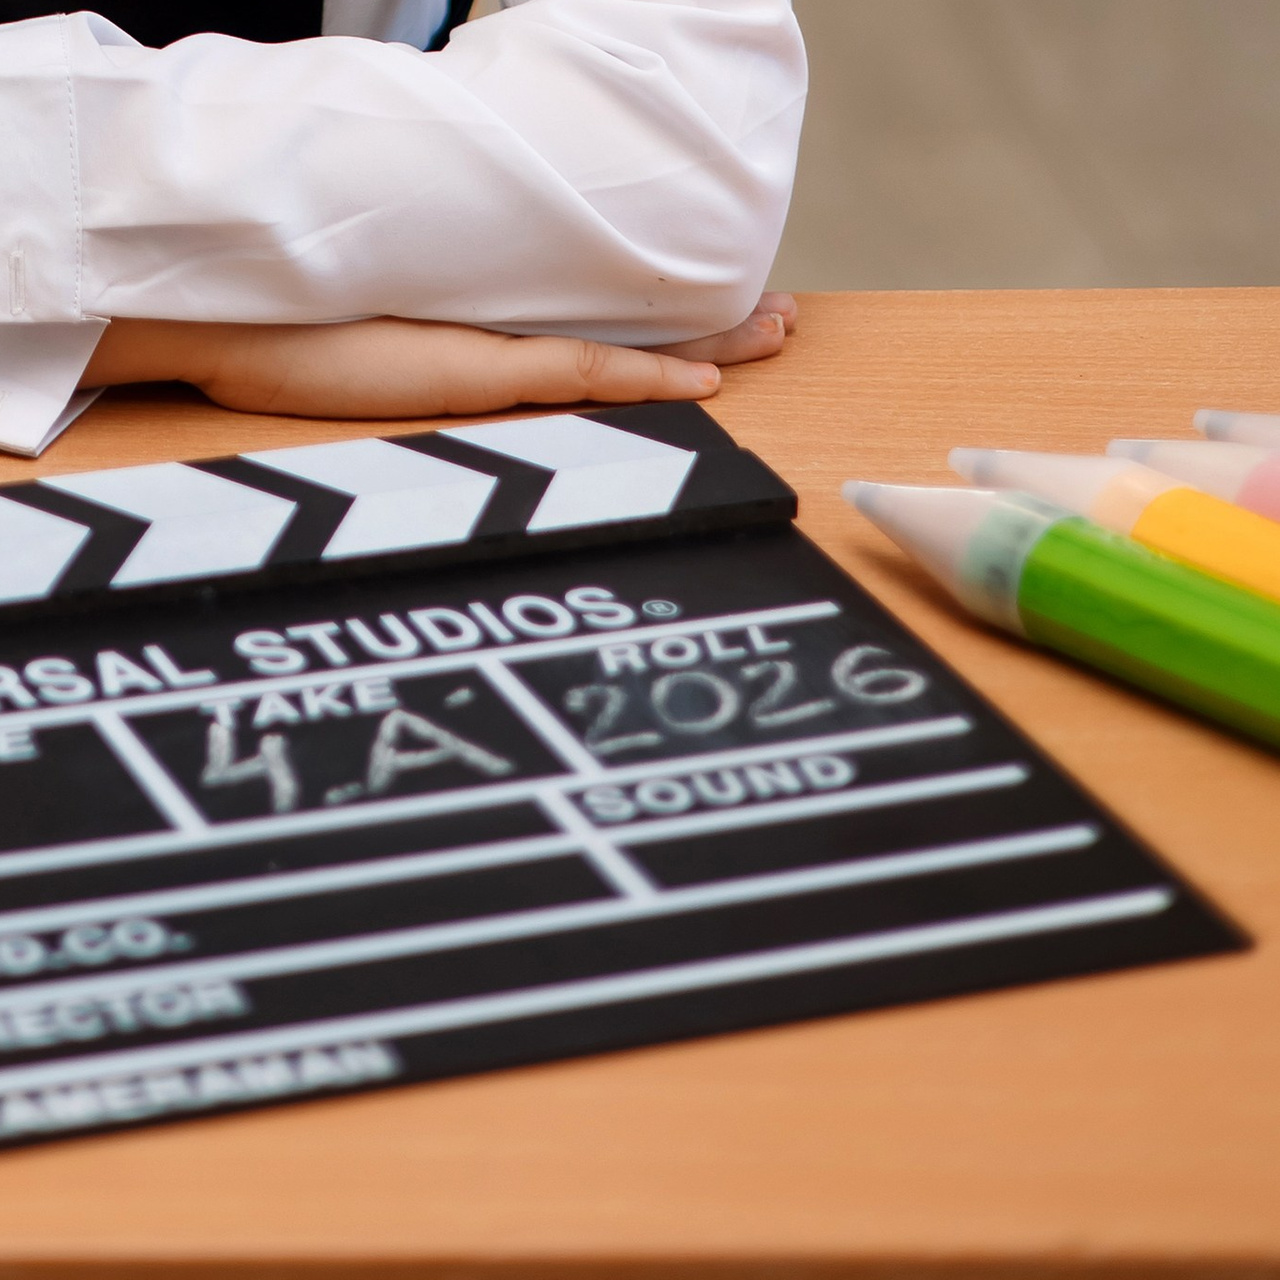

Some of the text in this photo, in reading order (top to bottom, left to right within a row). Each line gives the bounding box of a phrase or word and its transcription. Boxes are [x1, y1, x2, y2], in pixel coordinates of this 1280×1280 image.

[597, 625, 791, 677] ROLL
[200, 677, 399, 731] TAKE
[563, 644, 929, 756] 2026
[582, 754, 857, 822] SOUND
